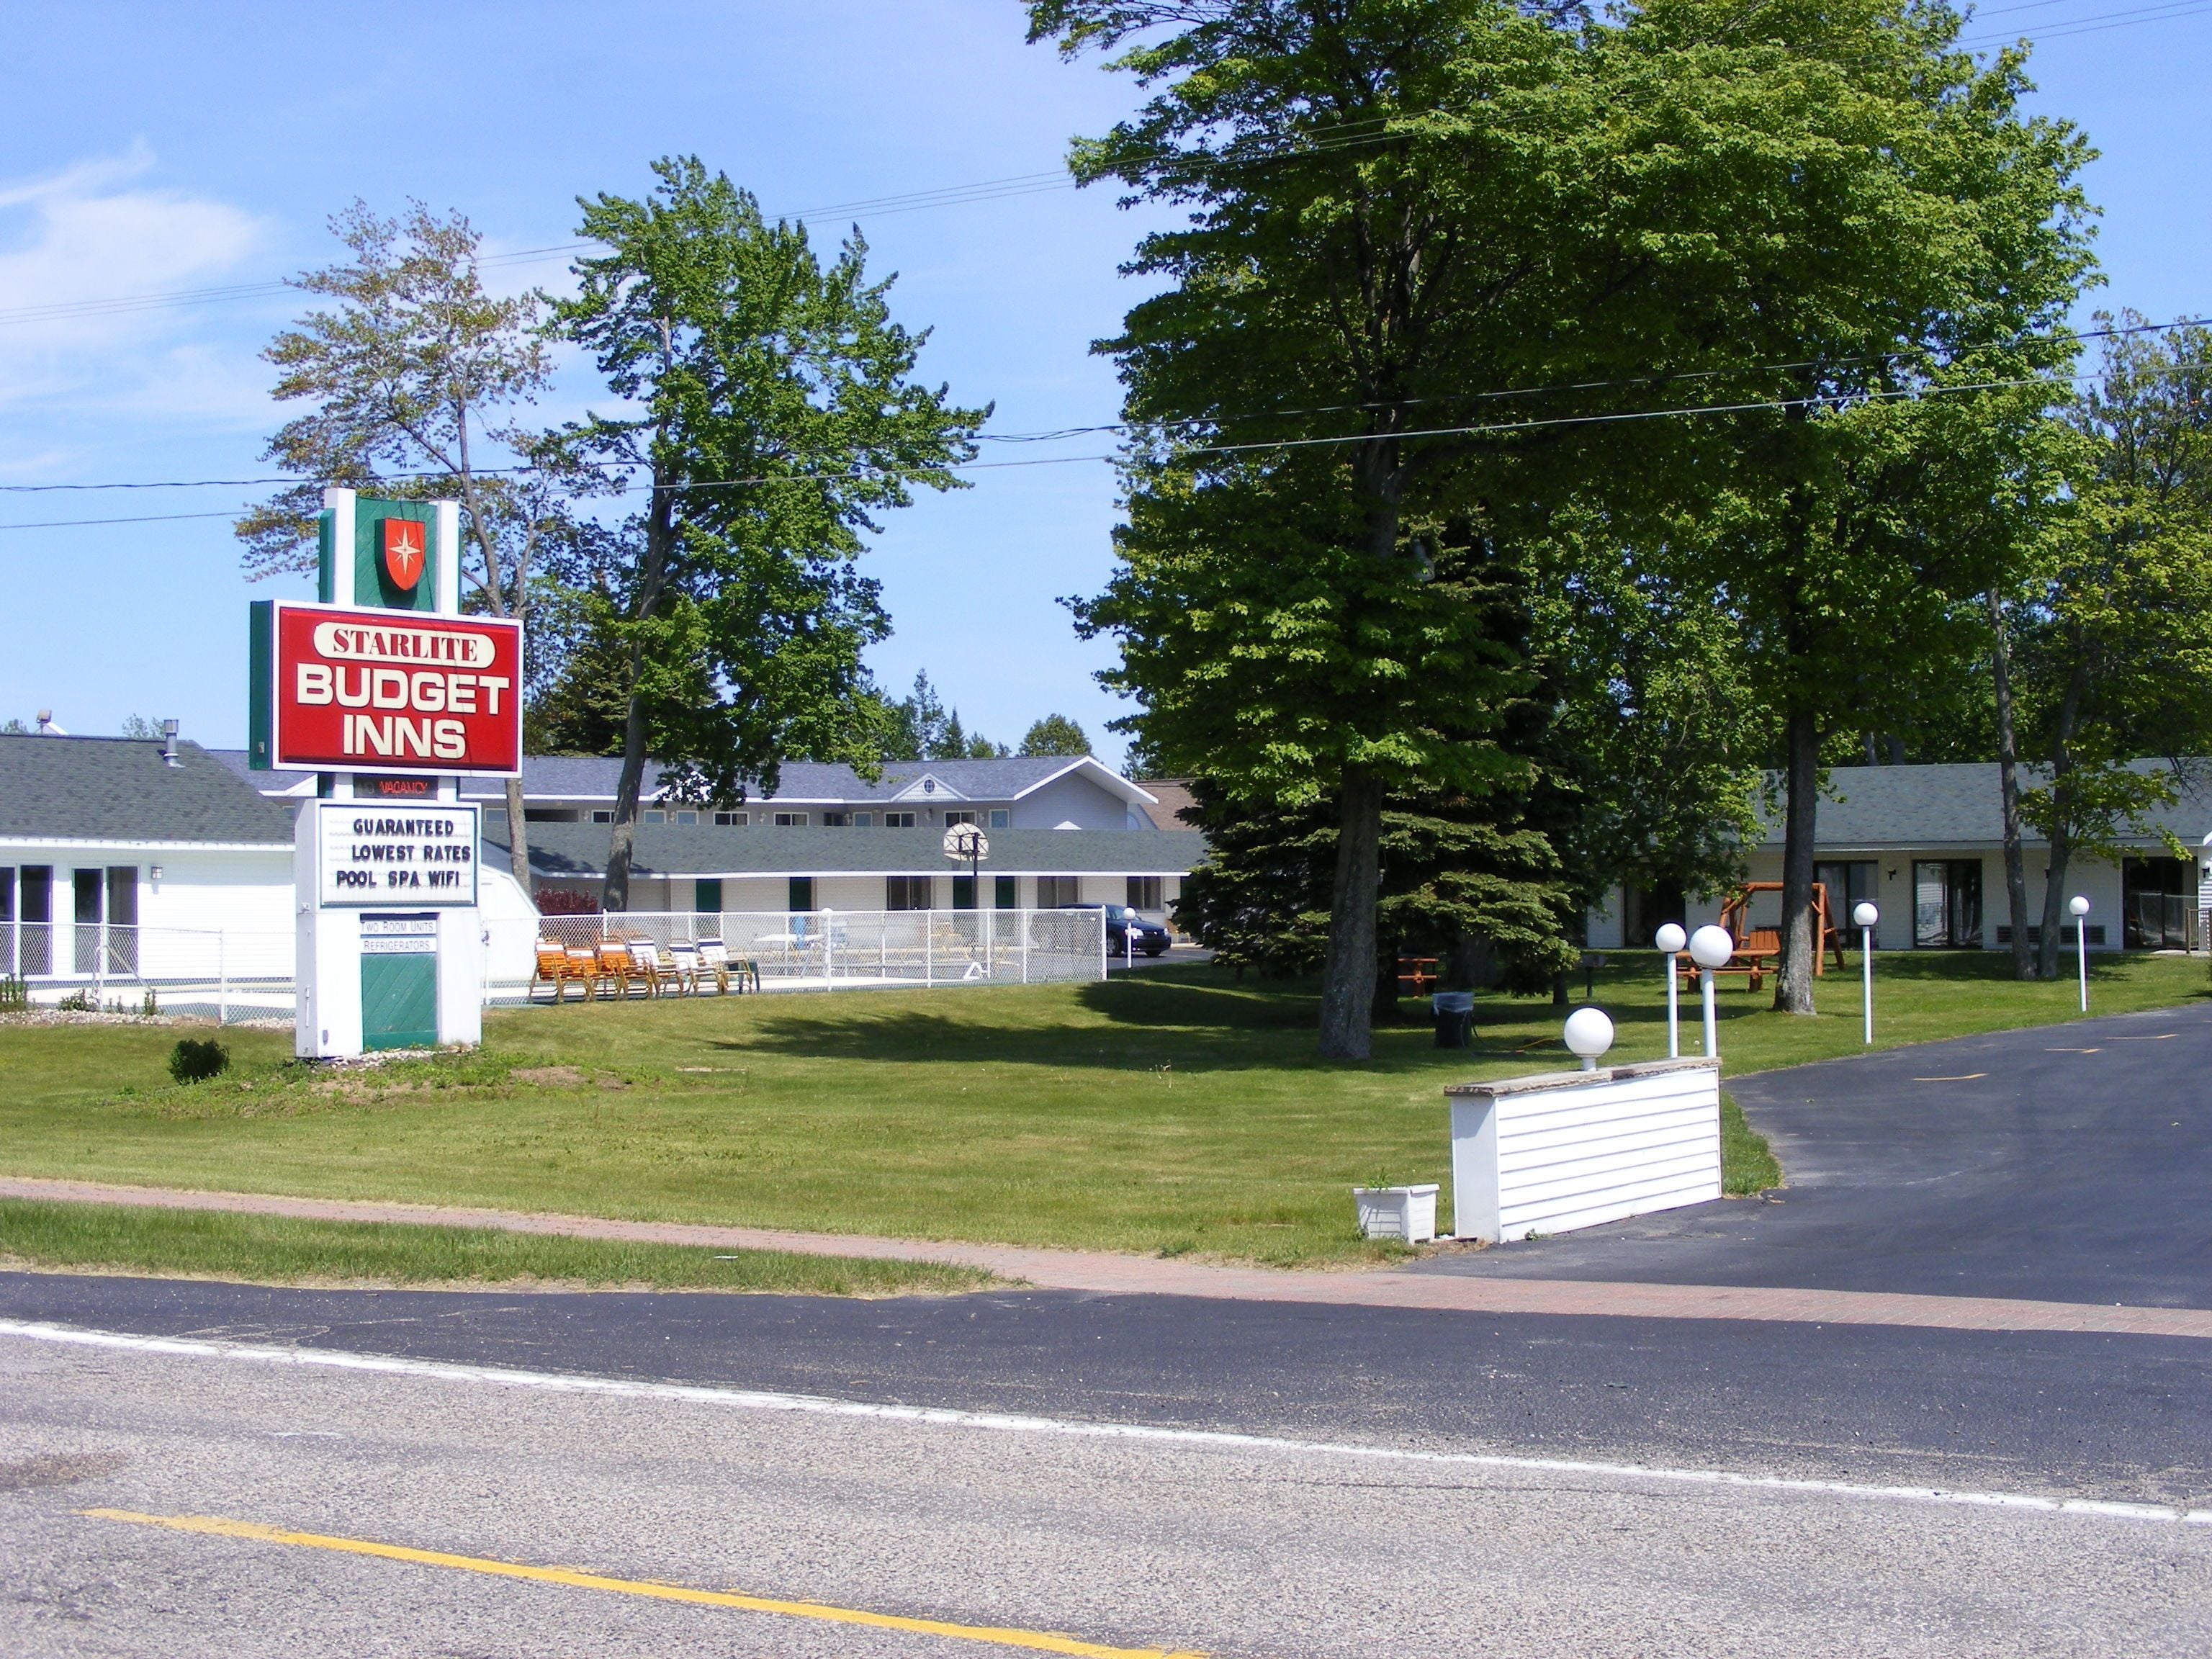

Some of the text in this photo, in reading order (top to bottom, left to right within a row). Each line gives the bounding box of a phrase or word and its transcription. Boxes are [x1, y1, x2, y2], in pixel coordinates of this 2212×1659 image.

[333, 629, 477, 662] STARLITE
[297, 662, 509, 715] BUDGET
[343, 714, 466, 759] INNS
[379, 781, 428, 794] VACANCY
[354, 819, 454, 836] GUARANTEED
[352, 845, 471, 861] LOWEST RATES
[336, 871, 459, 887] POOL SPA WIFI
[383, 921, 407, 932] ROOM
[410, 921, 433, 932] UNITS
[364, 940, 430, 950] REFRIGERATORS
